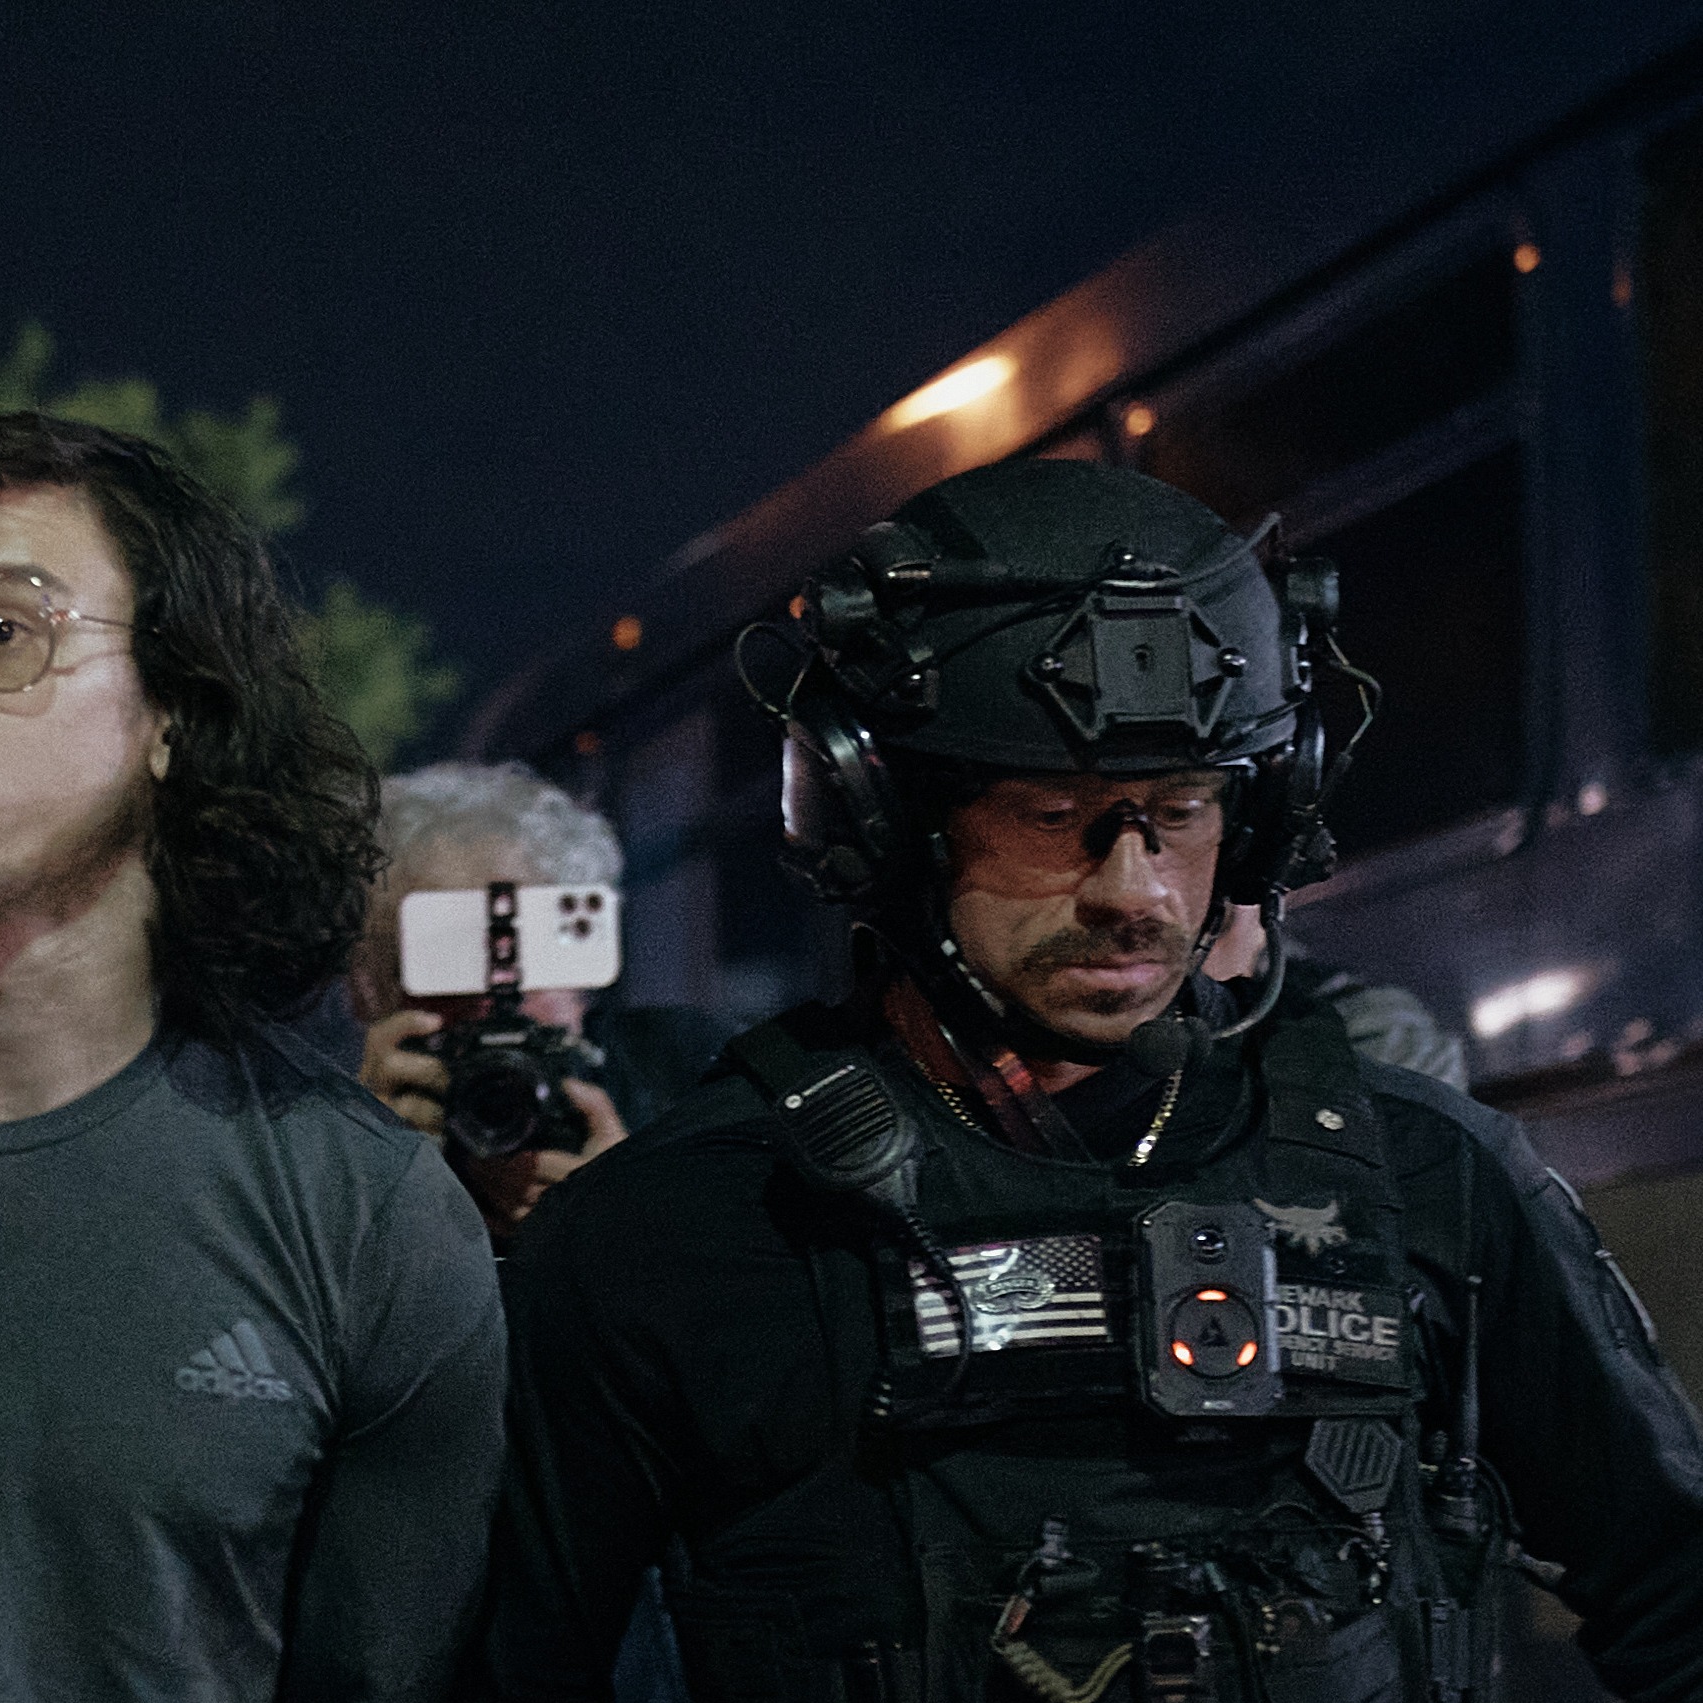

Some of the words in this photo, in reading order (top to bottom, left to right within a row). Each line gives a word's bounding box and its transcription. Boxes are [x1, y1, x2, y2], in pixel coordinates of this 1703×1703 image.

[1277, 1285, 1365, 1313] EWARK
[1275, 1304, 1400, 1346] OLICE
[174, 1360, 294, 1400] adidas
